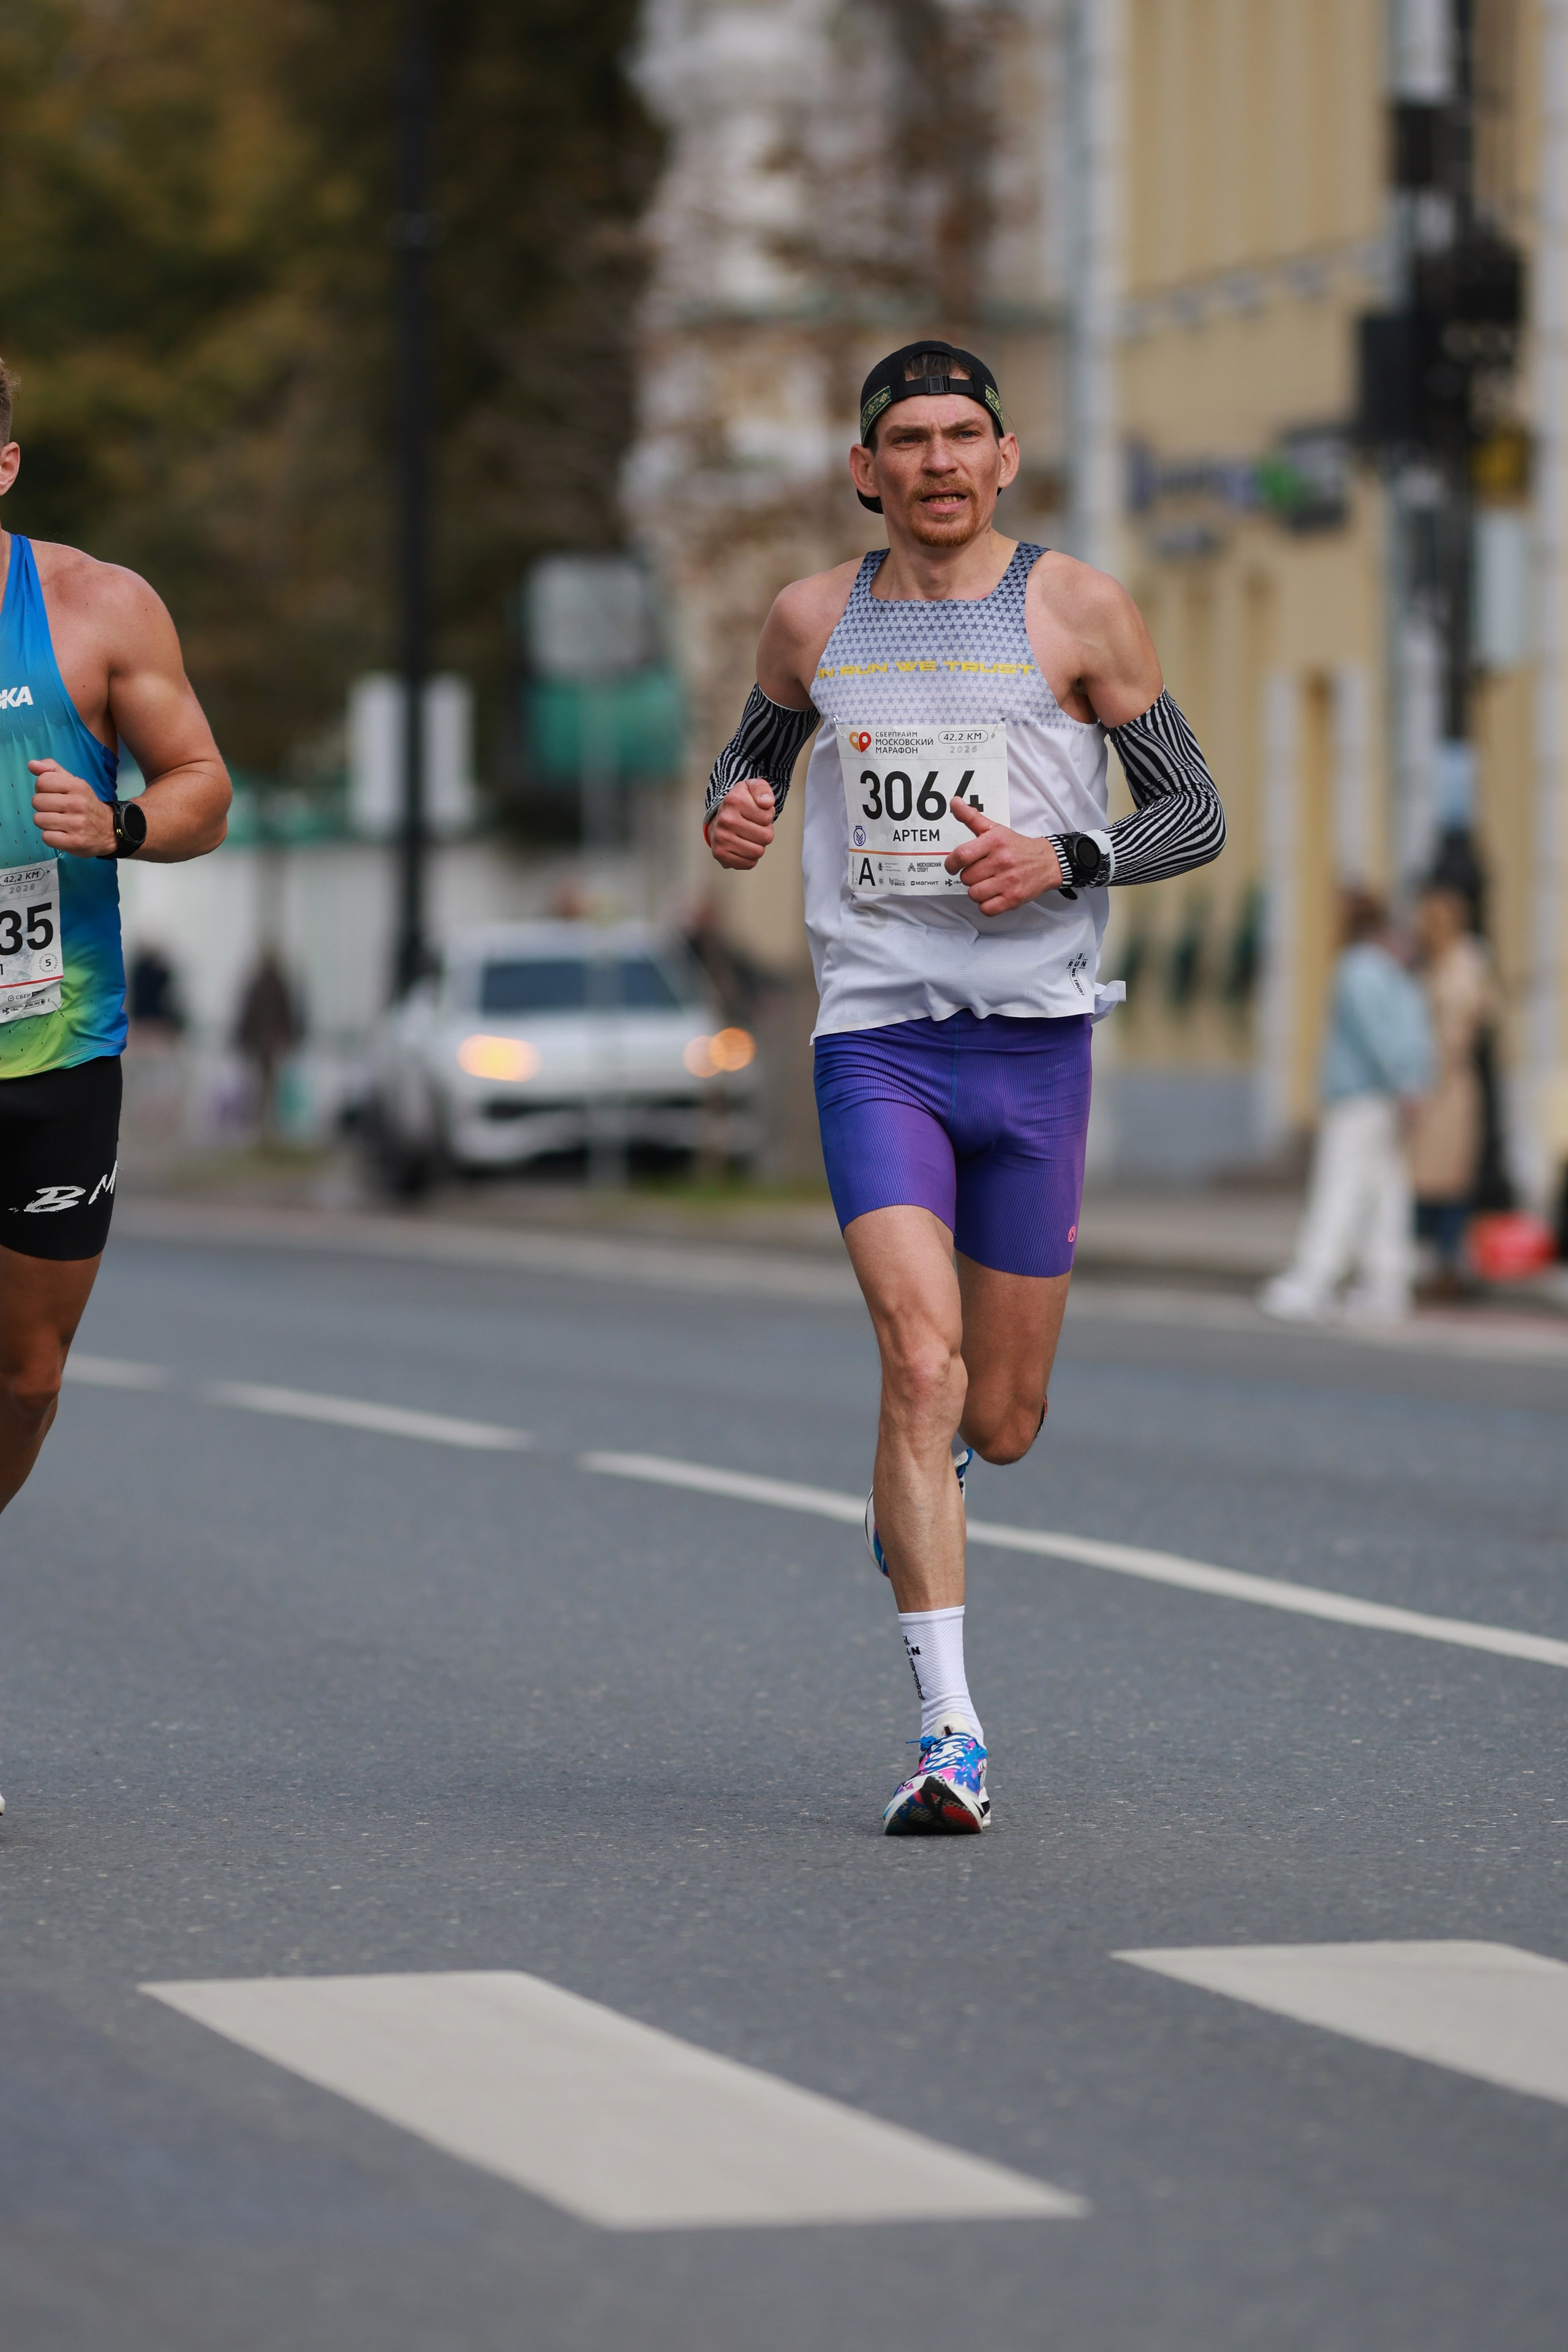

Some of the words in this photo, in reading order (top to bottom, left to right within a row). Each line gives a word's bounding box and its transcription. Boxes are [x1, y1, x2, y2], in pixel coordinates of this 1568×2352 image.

[818, 667, 834, 679] IN
[840, 662, 888, 676] RUN
[895, 660, 937, 672] WE
[943, 661, 1035, 676] TRUST
[944, 733, 963, 742] 42,2
[860, 770, 984, 821] 3064
[893, 829, 940, 842] АРТЕМ
[4, 874, 22, 883] 42,2
[25, 871, 39, 880] КМ
[9, 883, 35, 894] 2026
[45, 959, 51, 967] 5
[1074, 979, 1085, 996] TRUST
